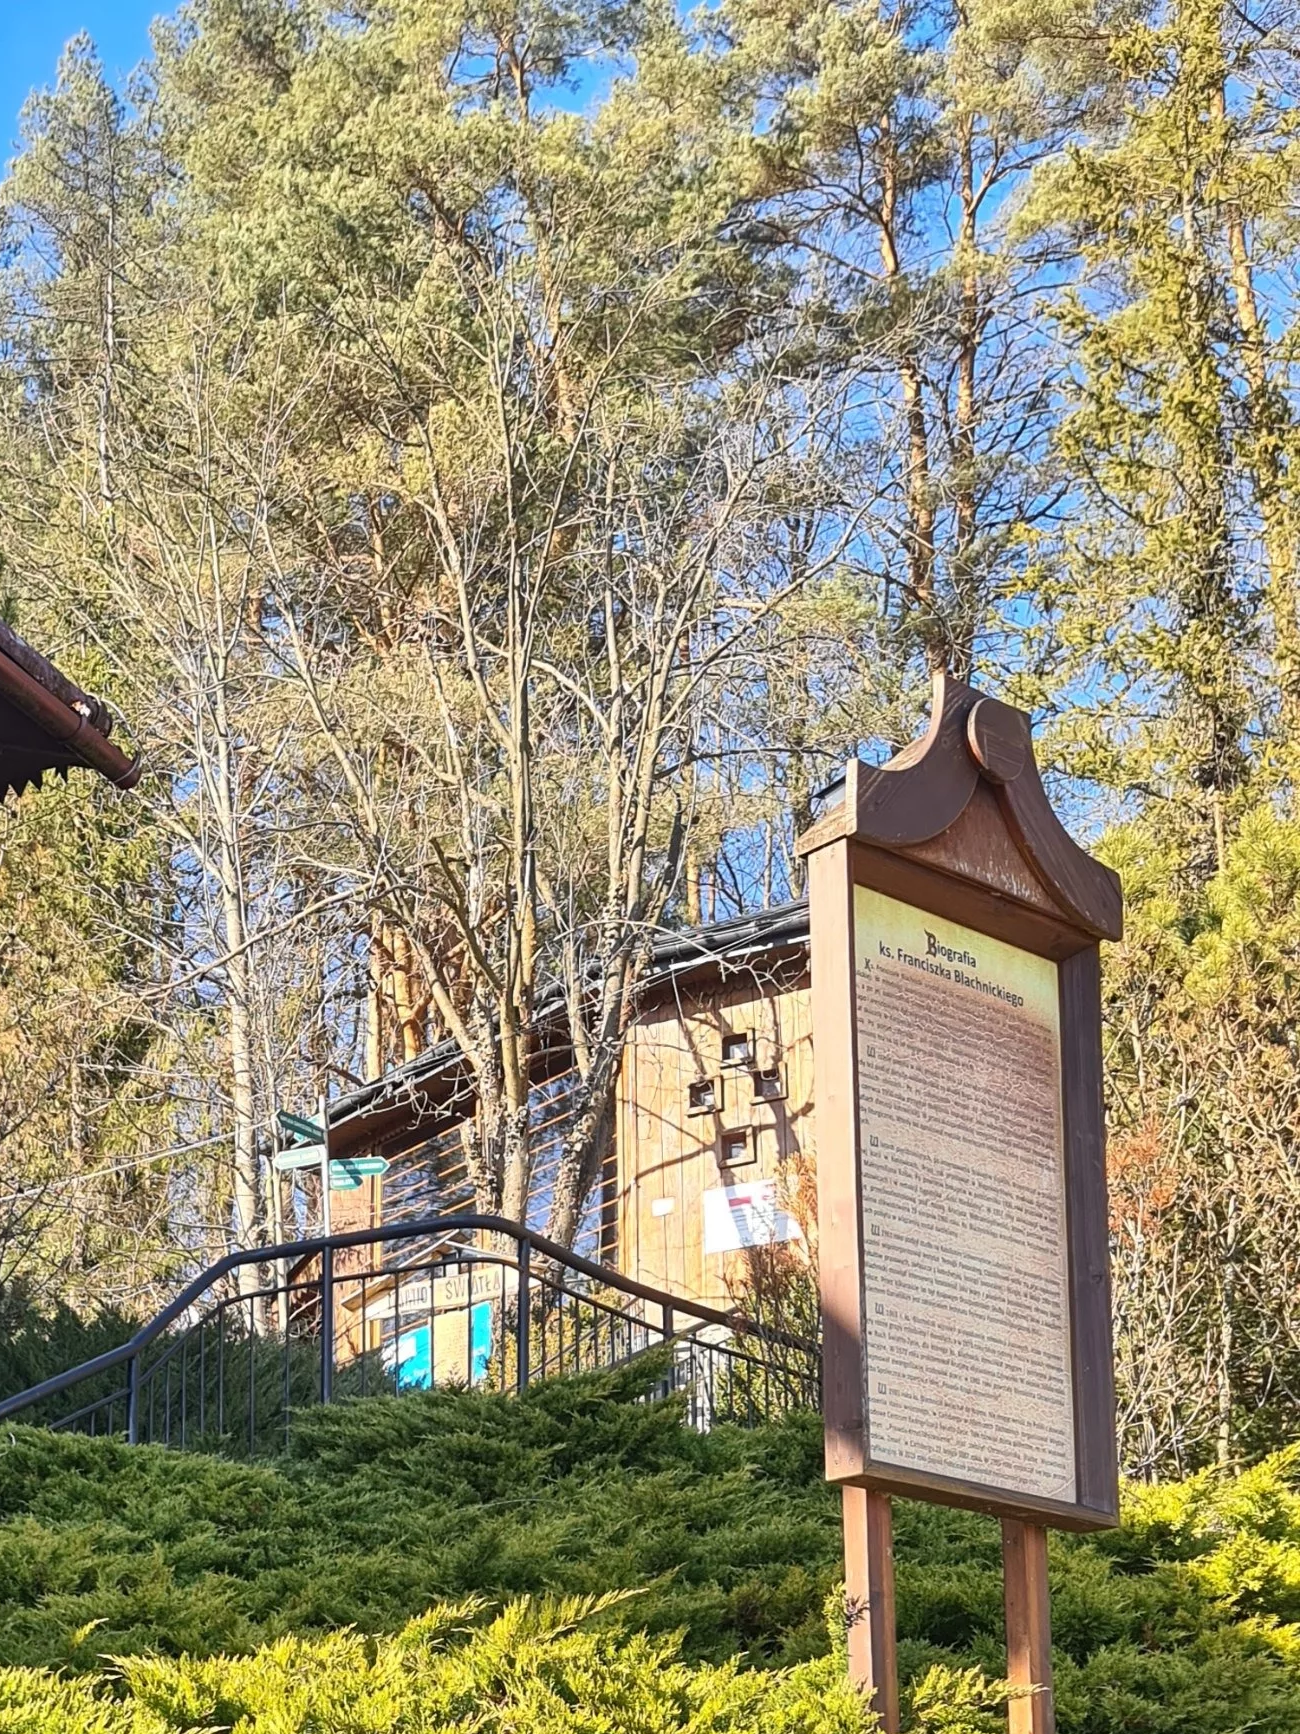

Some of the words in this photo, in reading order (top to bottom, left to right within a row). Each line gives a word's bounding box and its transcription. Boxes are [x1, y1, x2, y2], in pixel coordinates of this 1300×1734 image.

[879, 941, 895, 959] ks.
[897, 948, 951, 979] Franciszka
[924, 928, 977, 968] Biografia
[445, 1270, 501, 1300] ŚWATŁA
